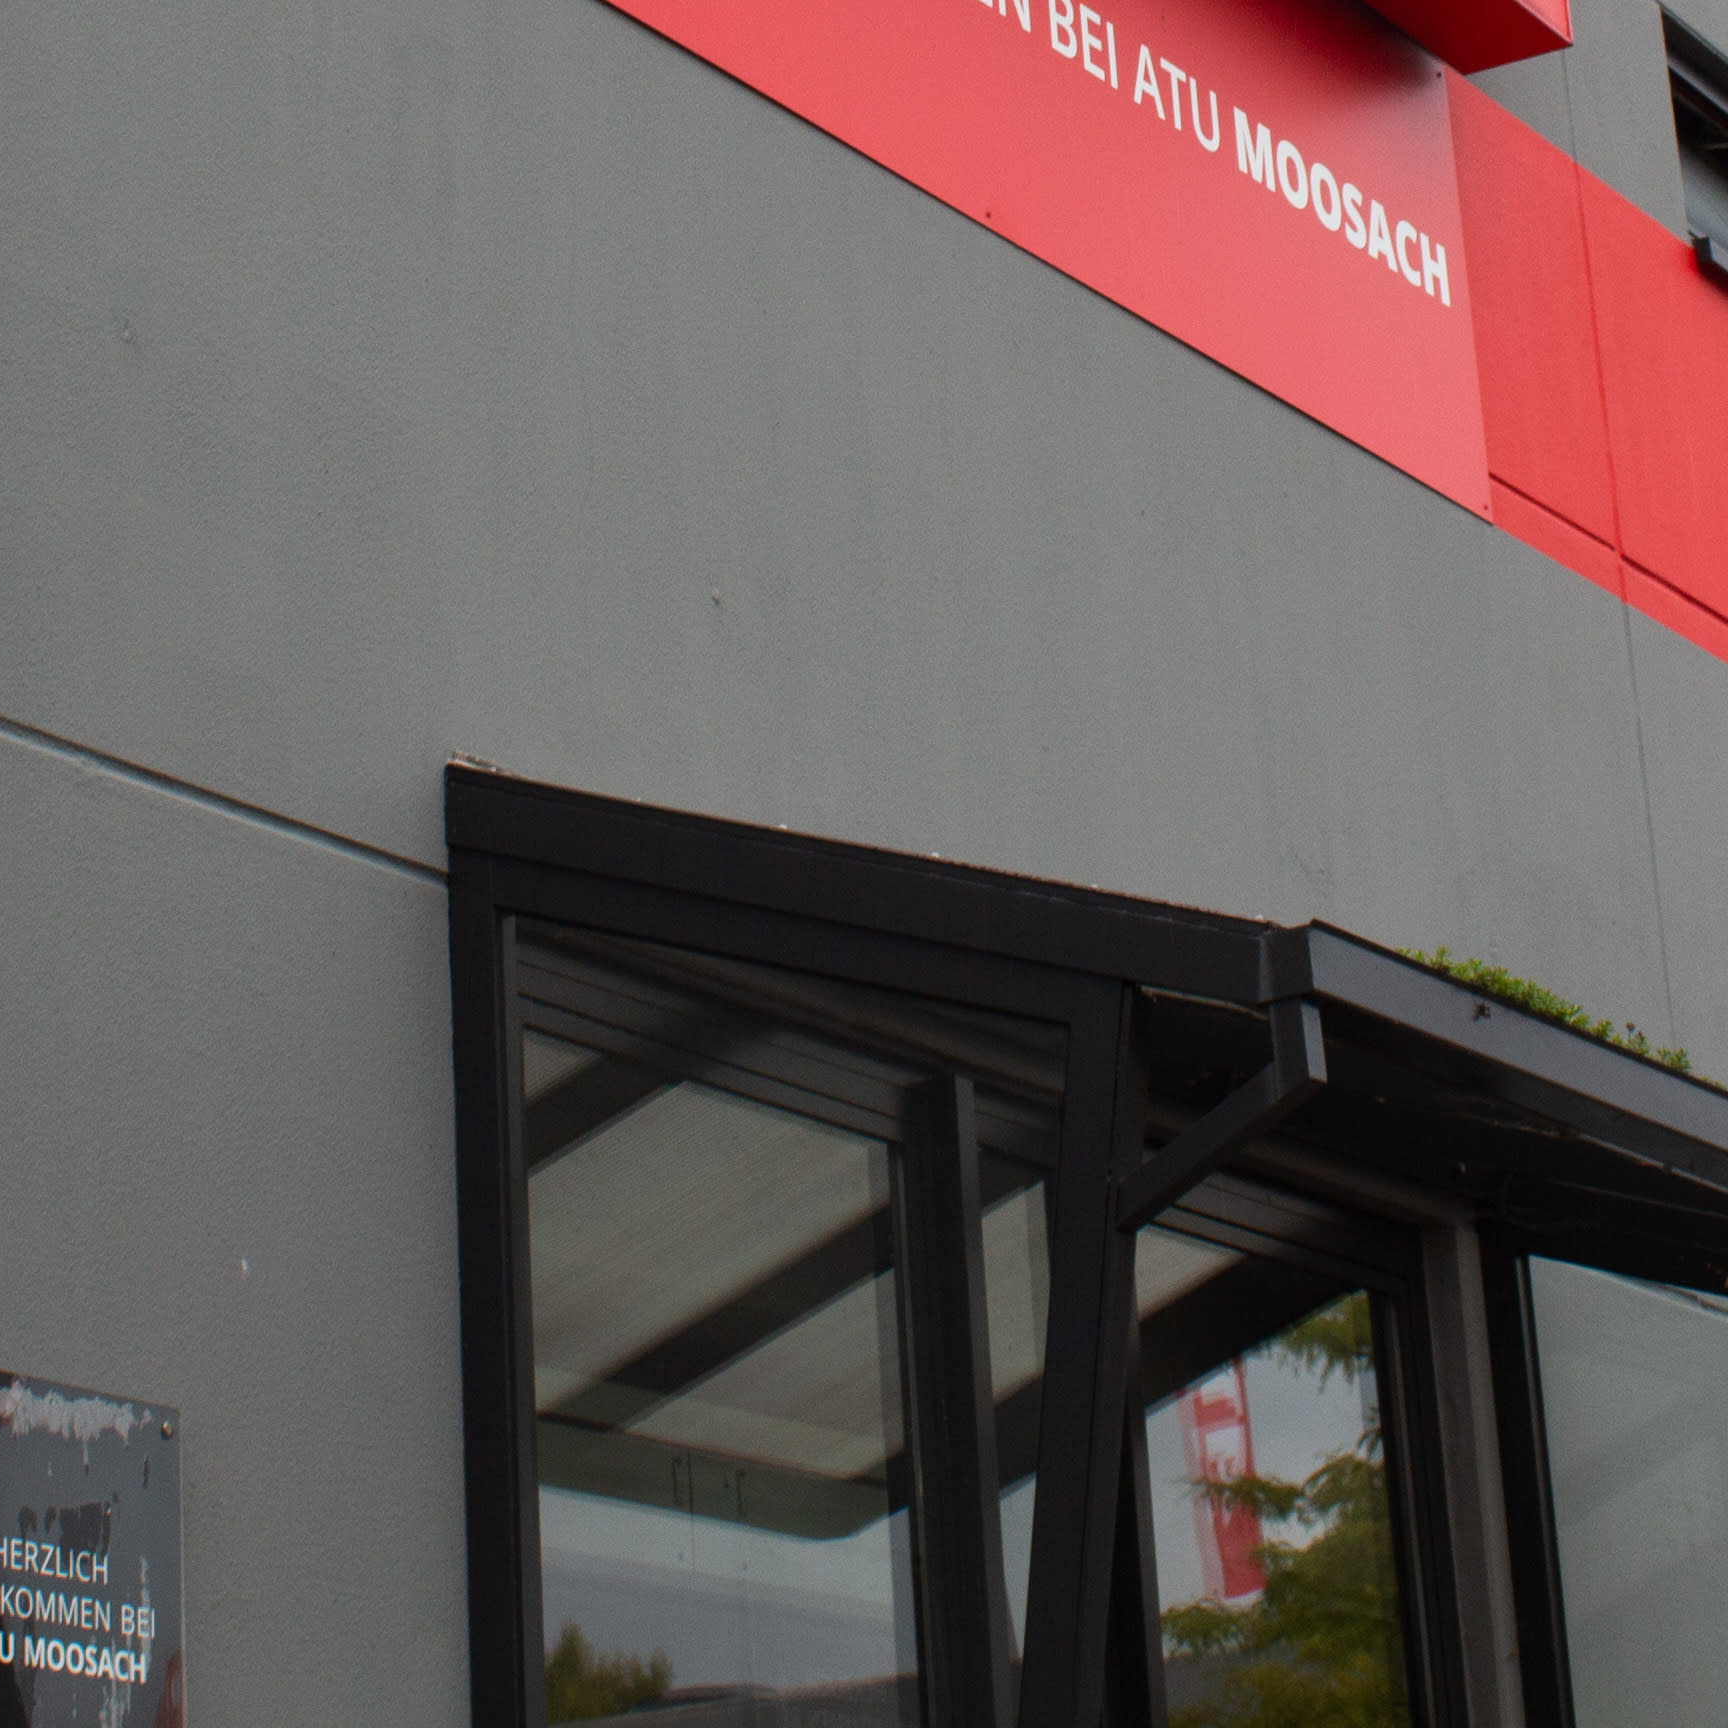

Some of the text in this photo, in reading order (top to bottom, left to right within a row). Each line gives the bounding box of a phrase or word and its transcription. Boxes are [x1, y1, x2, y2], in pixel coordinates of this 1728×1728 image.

[1133, 43, 1221, 153] ATU
[1233, 106, 1452, 308] MOOSACH
[120, 1603, 156, 1639] BEI
[24, 1634, 147, 1685] MOOSACH
